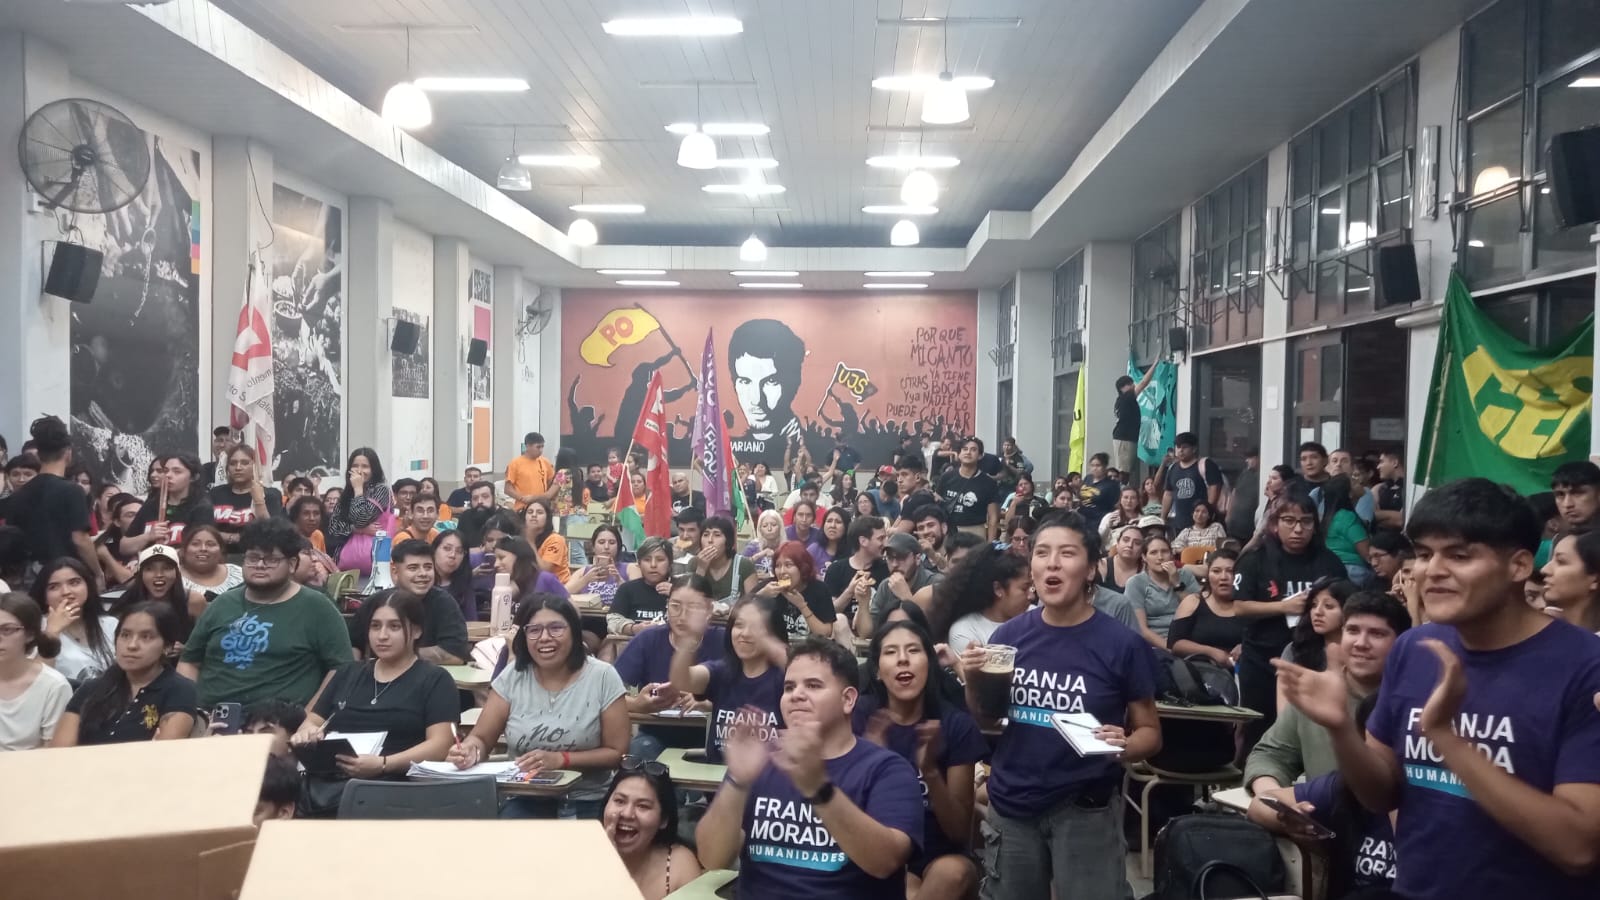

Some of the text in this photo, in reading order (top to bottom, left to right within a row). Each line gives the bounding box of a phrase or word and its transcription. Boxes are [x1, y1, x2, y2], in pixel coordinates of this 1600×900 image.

[600, 317, 633, 346] PO
[917, 327, 966, 344] POR QUE
[911, 344, 972, 368] MI CANTO
[839, 369, 868, 394] UJS
[930, 368, 970, 381] YA TIENE
[900, 375, 971, 400] OTRAS BOCAS
[887, 403, 917, 417] PUEDE
[923, 391, 953, 407] NADIE
[955, 401, 968, 411] LO
[1011, 668, 1087, 694] RANJA
[717, 709, 778, 726] FRANJA
[1407, 708, 1515, 743] FNJA
[754, 797, 822, 824] FRAN
[749, 845, 845, 862] HUMANIDADES
